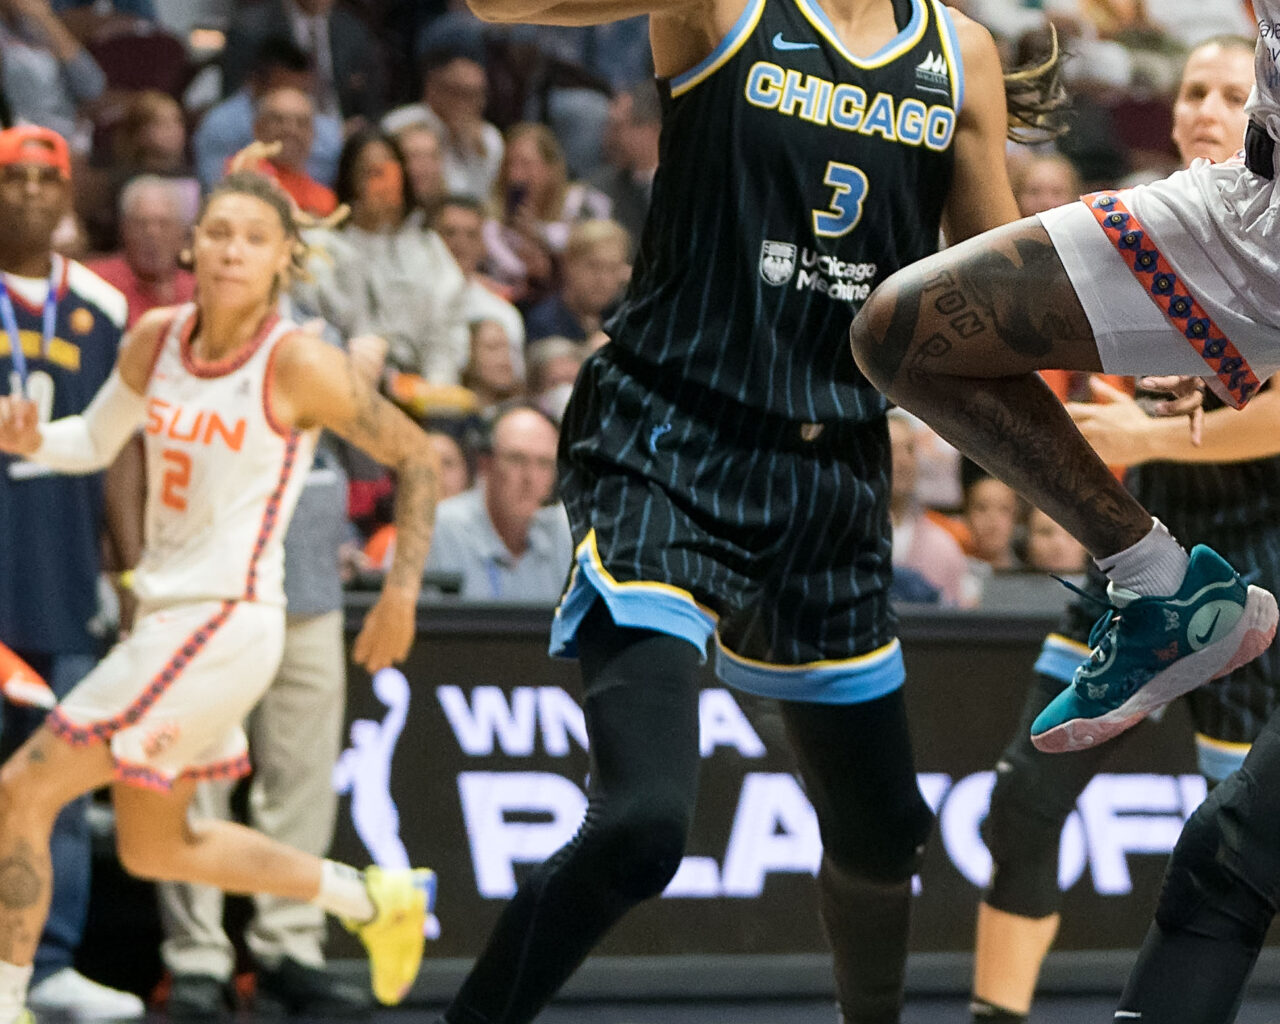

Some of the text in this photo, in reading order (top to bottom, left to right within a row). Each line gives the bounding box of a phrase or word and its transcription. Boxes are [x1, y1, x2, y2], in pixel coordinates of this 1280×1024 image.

[744, 61, 956, 152] CHICAGO
[811, 160, 869, 238] 3
[796, 269, 871, 301] Medine
[145, 396, 247, 454] SUN
[159, 448, 193, 513] 2
[436, 684, 766, 758] WNA
